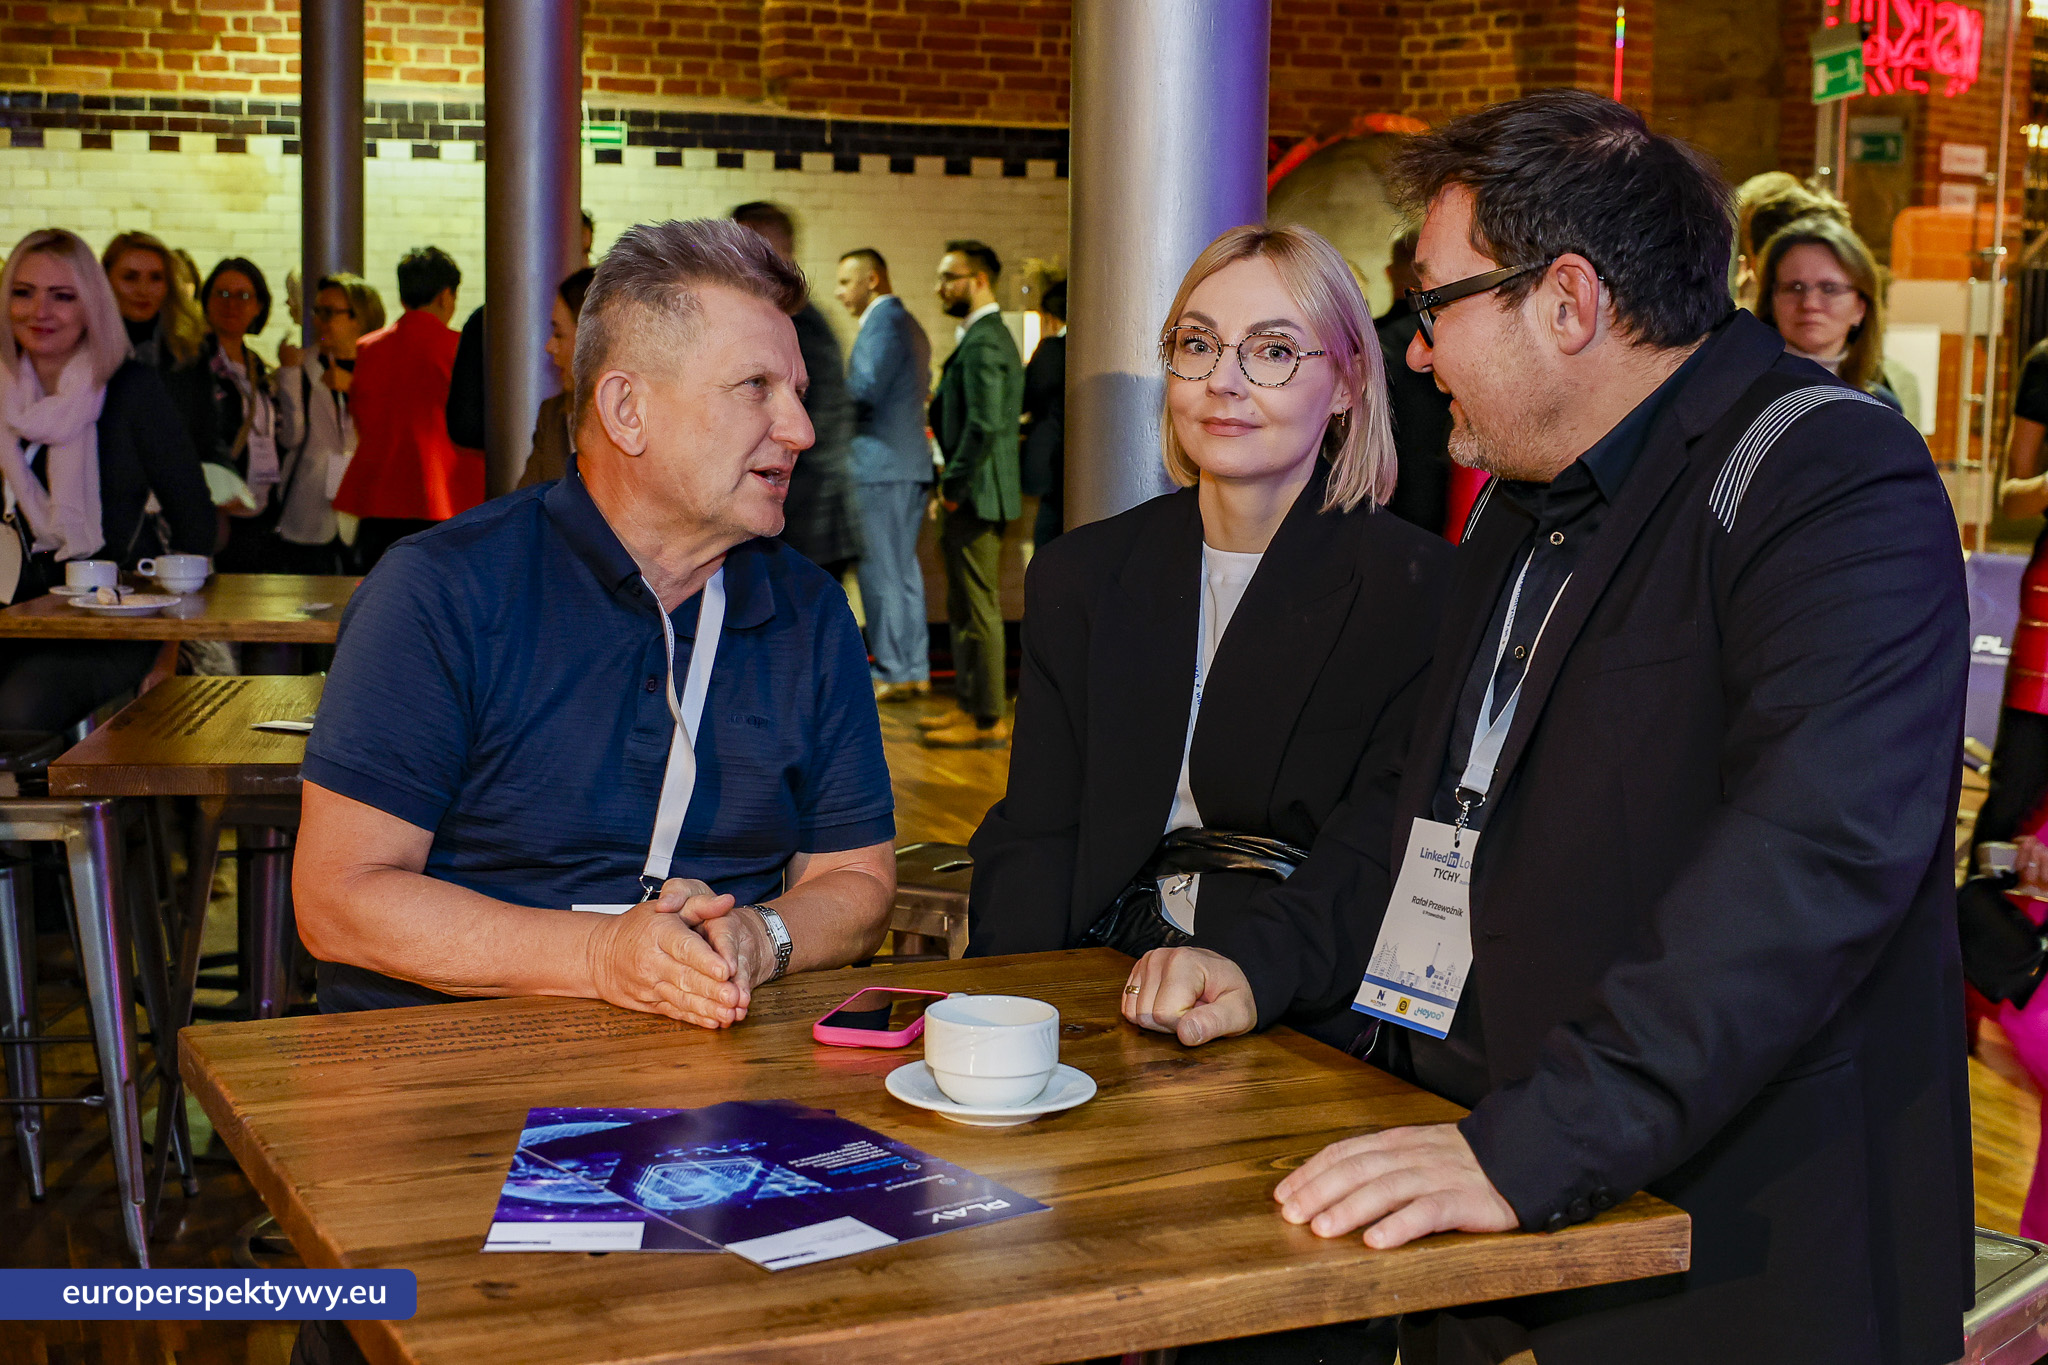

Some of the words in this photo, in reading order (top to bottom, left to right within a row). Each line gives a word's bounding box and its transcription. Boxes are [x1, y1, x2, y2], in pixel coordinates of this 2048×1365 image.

[1433, 867, 1461, 883] TYCHY
[1411, 895, 1429, 907] Rafał
[1427, 900, 1464, 917] Przewoźnik
[931, 1199, 1011, 1225] PLAY
